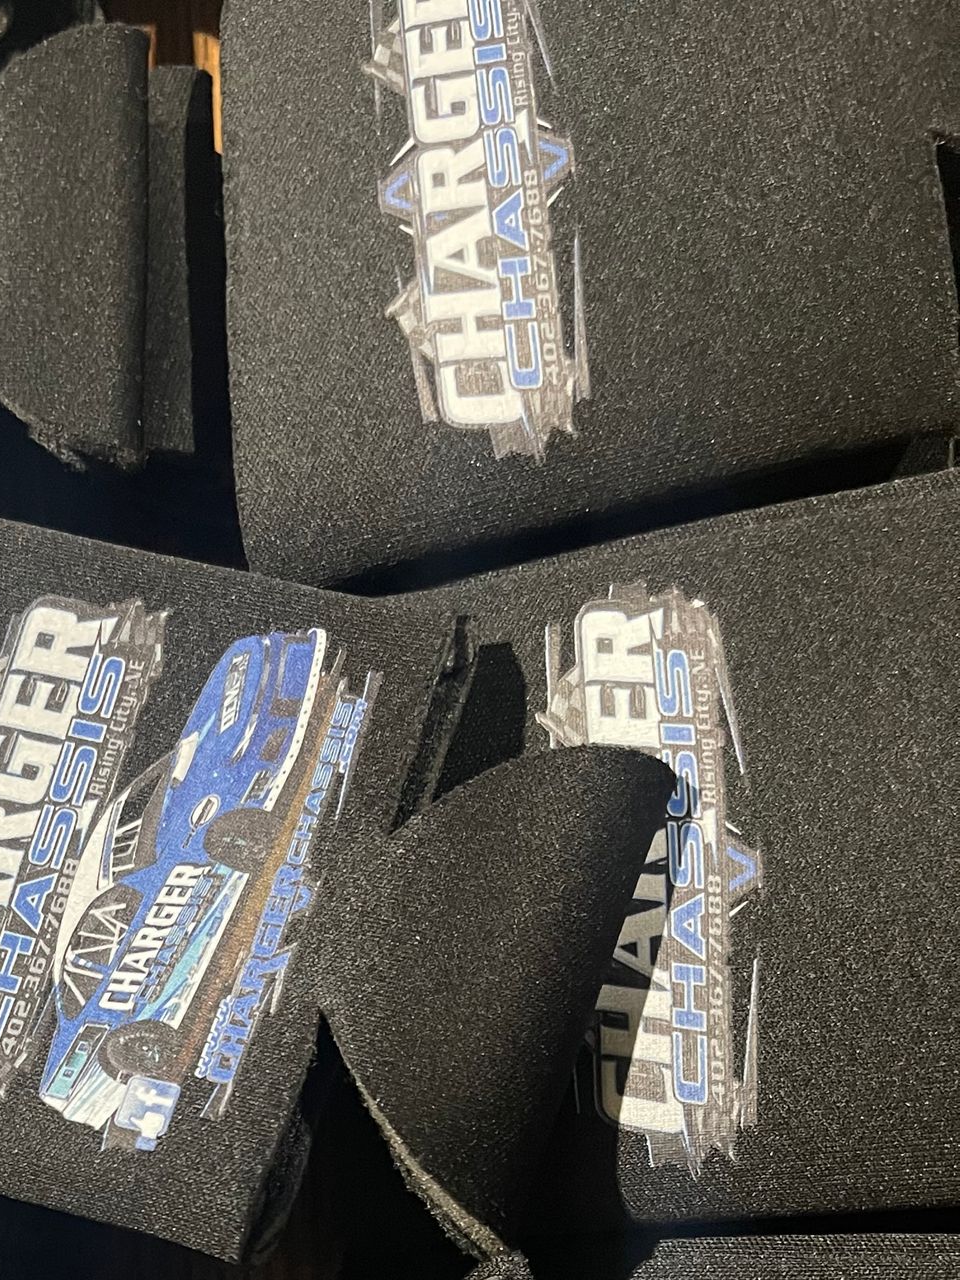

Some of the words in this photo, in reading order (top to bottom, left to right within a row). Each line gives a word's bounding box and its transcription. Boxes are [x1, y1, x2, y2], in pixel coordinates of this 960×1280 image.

[511, 52, 528, 107] Rising
[90, 738, 127, 796] Rising
[123, 659, 145, 683] NE
[691, 648, 708, 676] NE
[698, 738, 719, 803] Rising
[580, 607, 684, 1128] CHAER
[655, 648, 707, 1104] CHASSIS
[97, 861, 210, 1012] CHARGER
